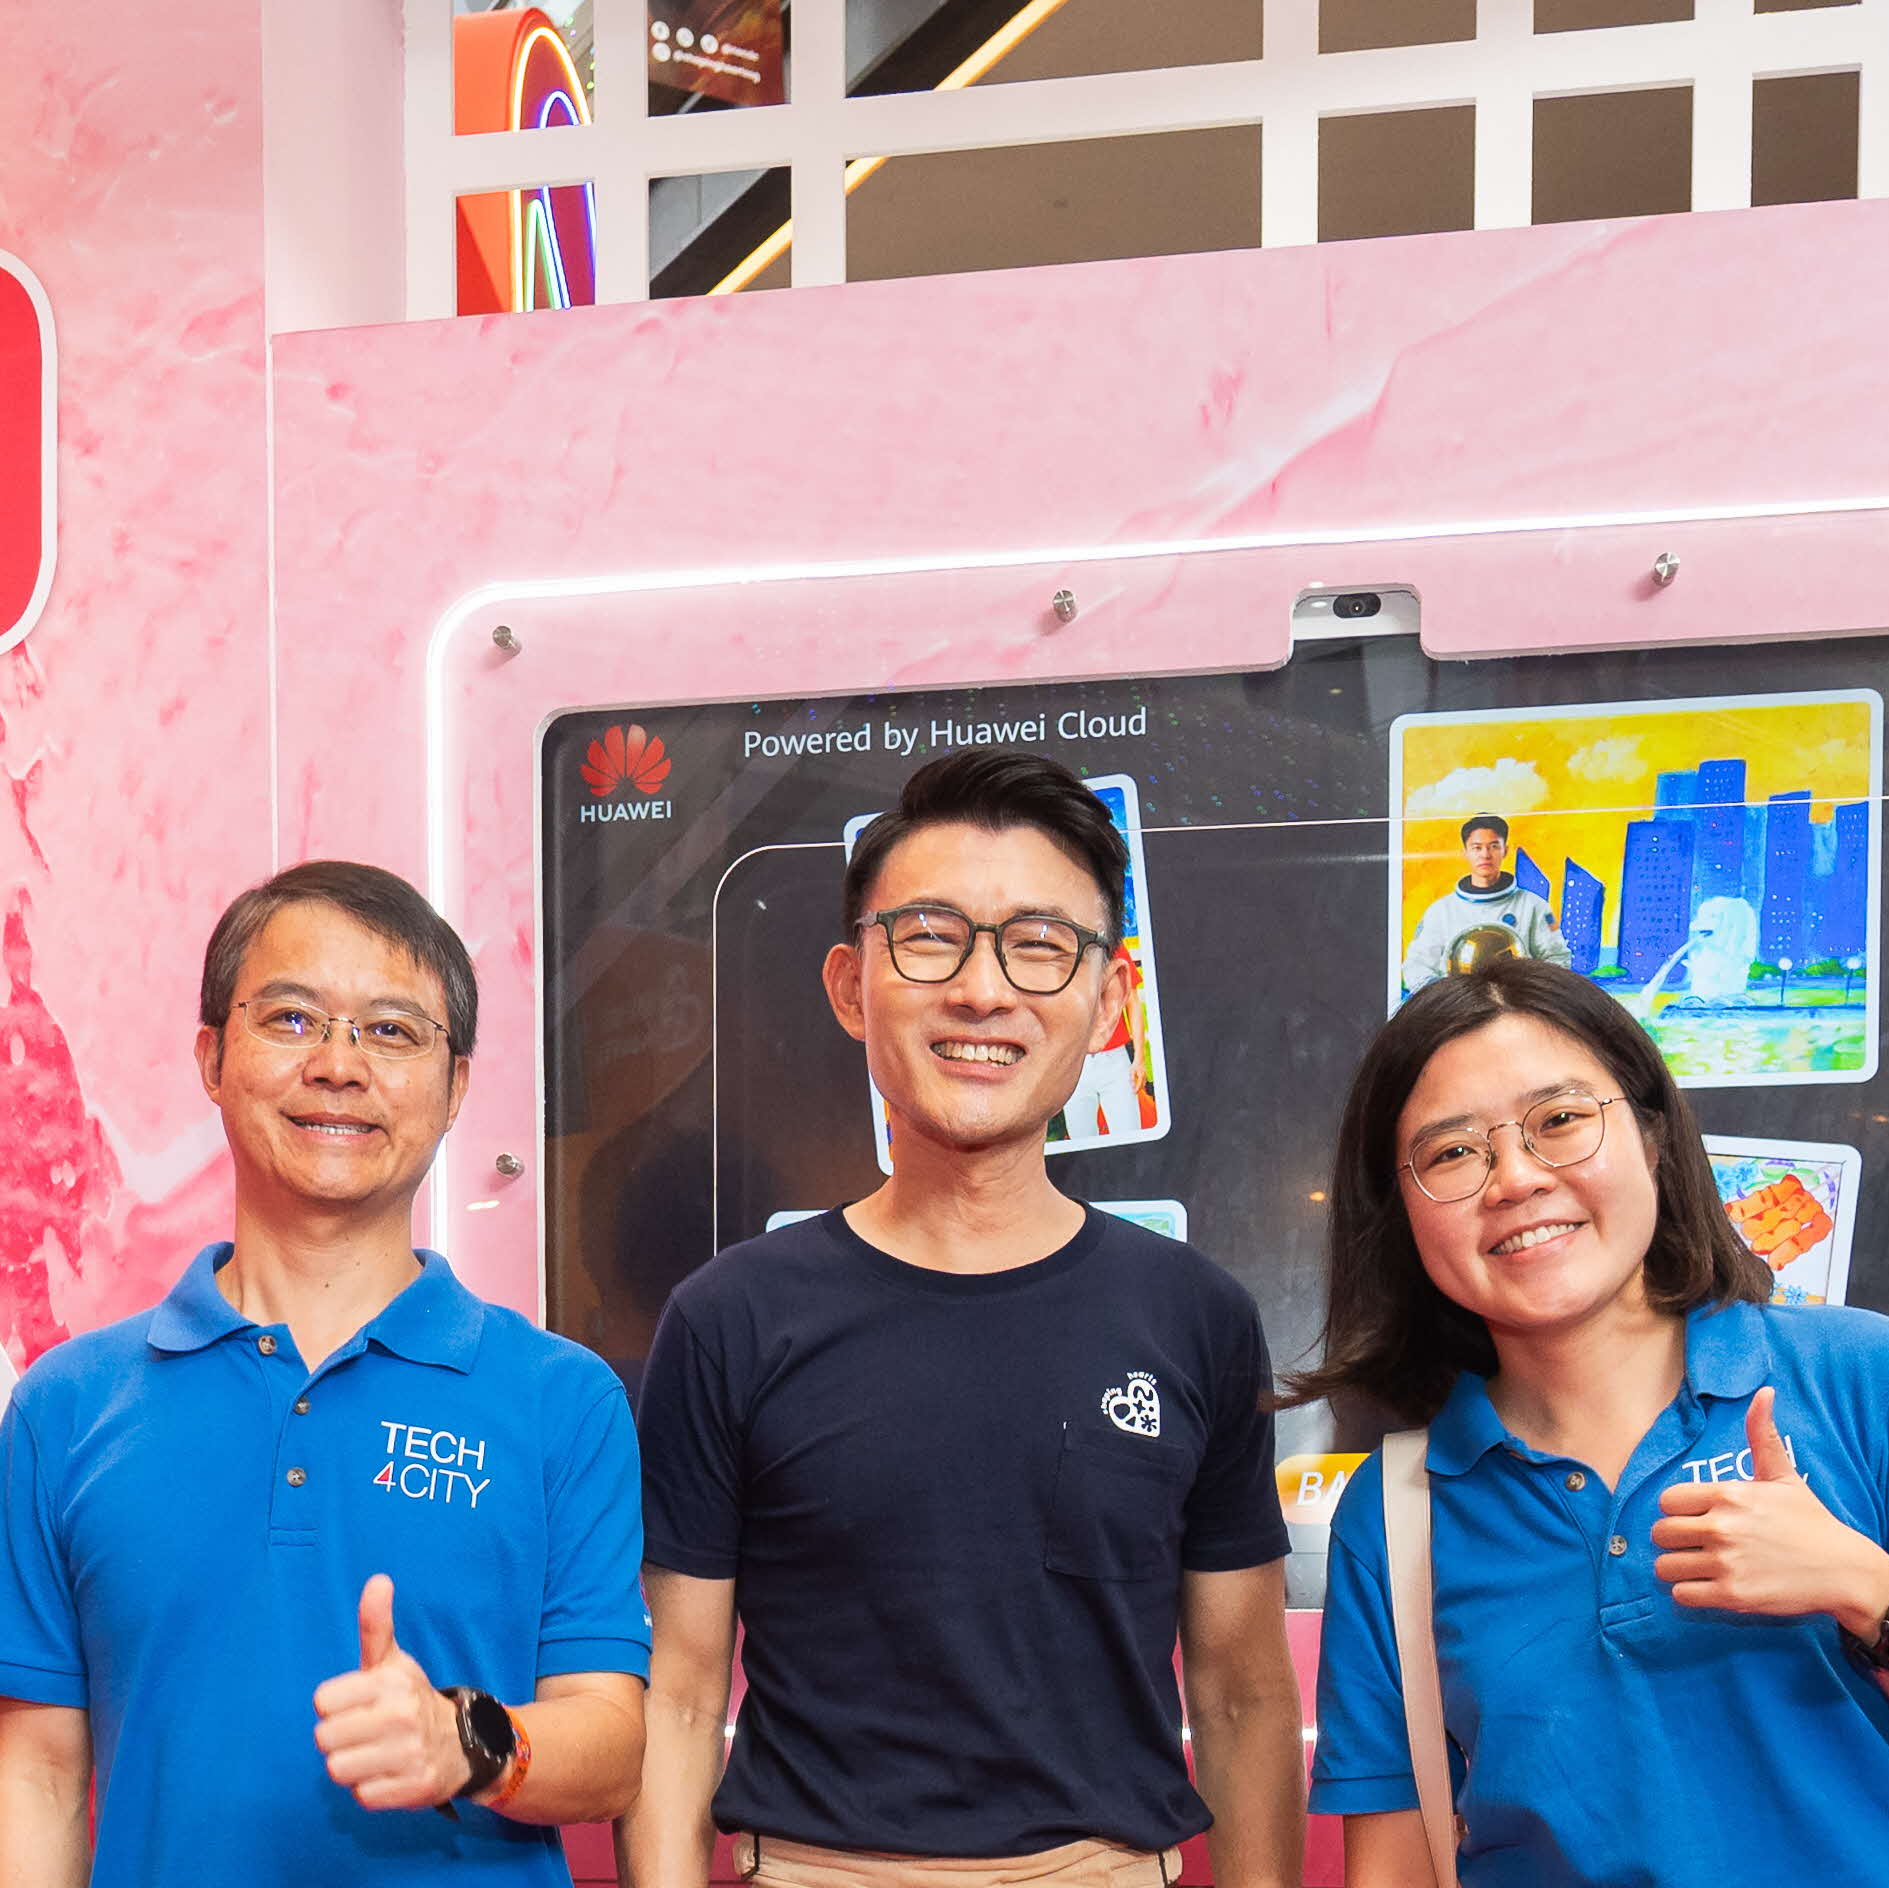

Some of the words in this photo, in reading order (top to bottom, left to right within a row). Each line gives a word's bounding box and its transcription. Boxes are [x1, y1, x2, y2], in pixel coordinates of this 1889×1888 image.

[745, 723, 870, 757] Powered
[885, 722, 918, 755] by
[931, 714, 1045, 746] Huawei
[1058, 707, 1145, 739] Cloud
[581, 801, 671, 822] HUAWEI
[380, 1420, 486, 1471] TECH
[372, 1460, 491, 1509] 4CITY
